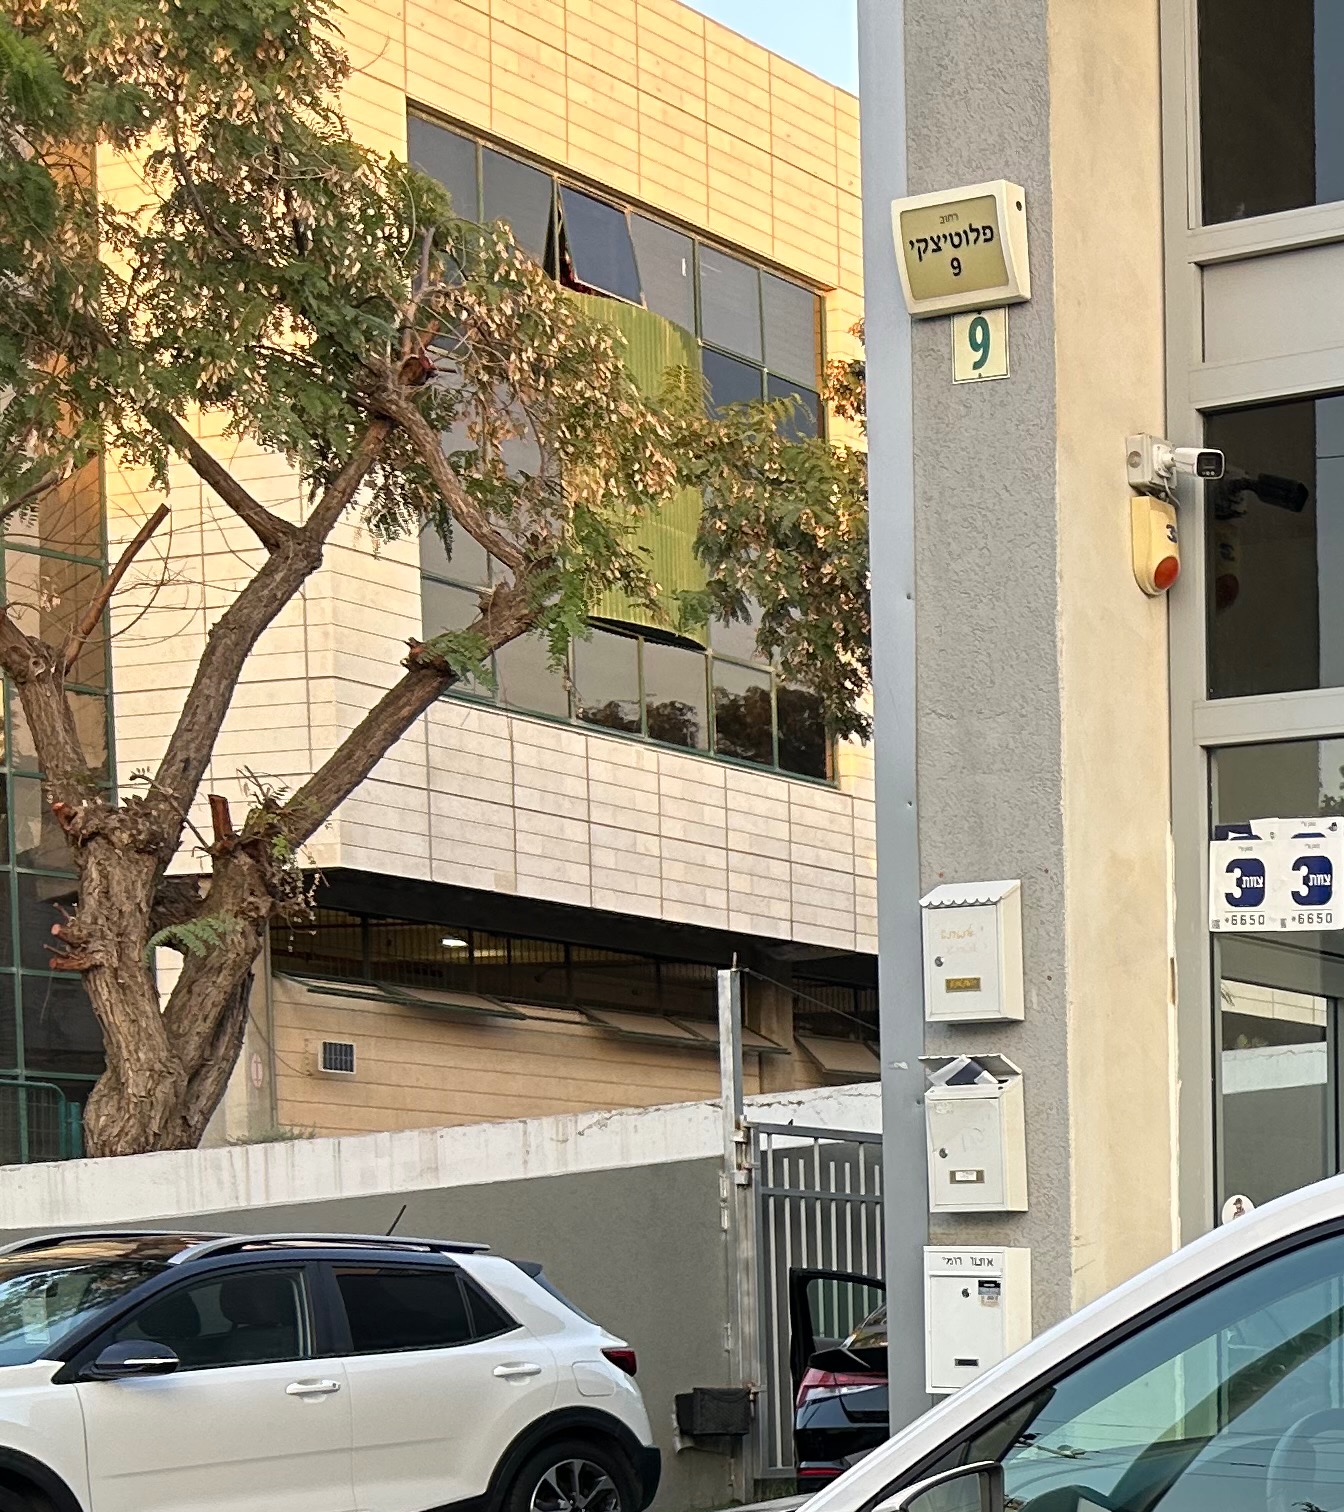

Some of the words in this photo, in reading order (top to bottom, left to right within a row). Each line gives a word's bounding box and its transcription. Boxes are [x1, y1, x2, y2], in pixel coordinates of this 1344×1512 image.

[908, 223, 995, 262] פלוטיצקי
[950, 257, 963, 277] 9
[968, 315, 991, 371] 9
